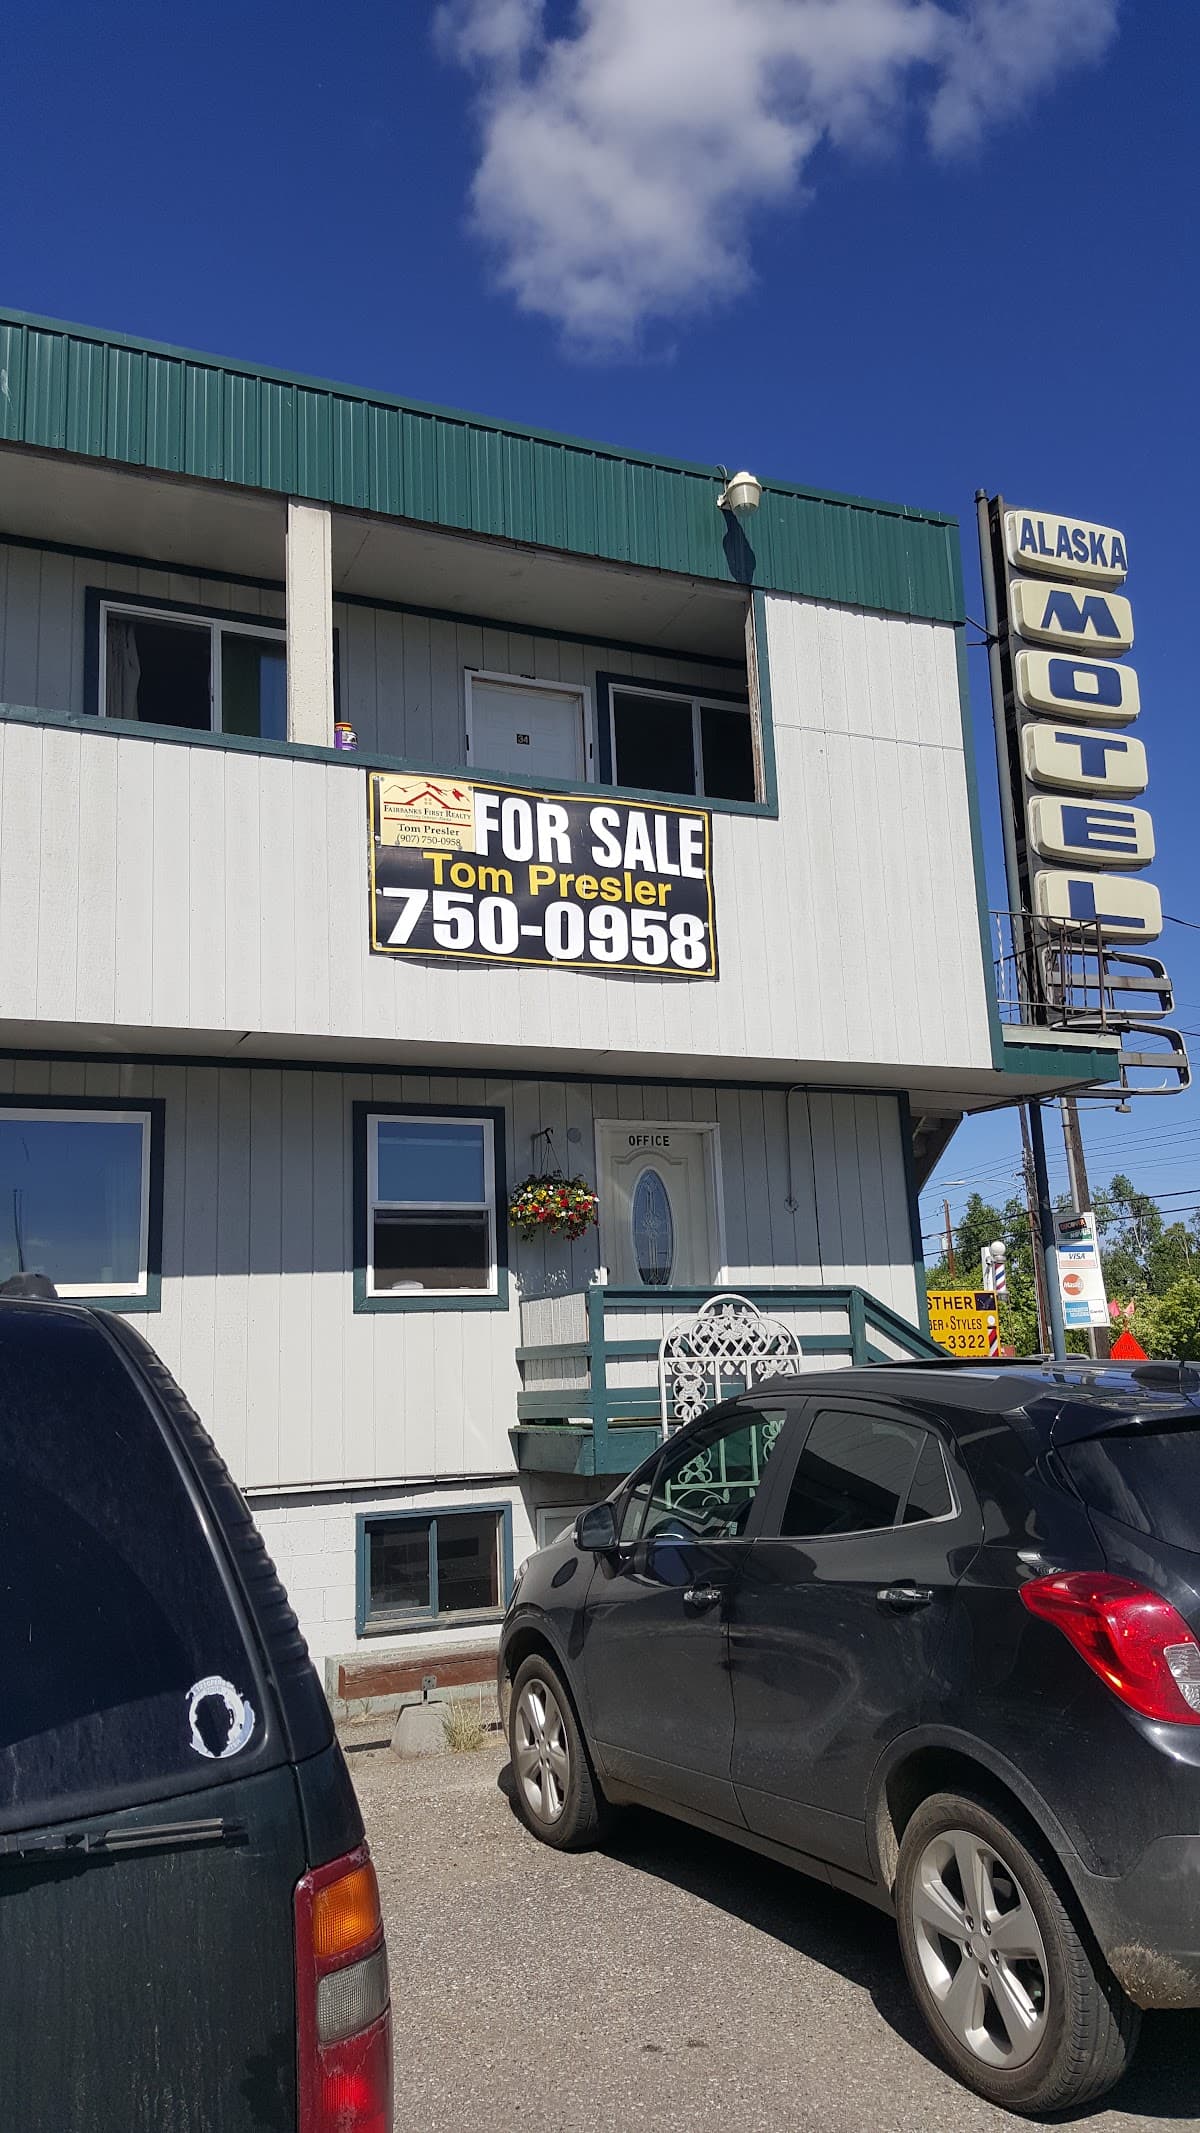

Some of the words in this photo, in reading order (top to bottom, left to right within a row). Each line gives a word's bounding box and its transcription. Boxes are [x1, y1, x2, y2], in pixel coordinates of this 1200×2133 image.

[1020, 517, 1127, 571] ALASKA
[1041, 590, 1146, 929] MOTEL
[397, 834, 419, 844] (907)
[421, 835, 461, 847] 750-0958
[398, 823, 420, 833] Tom
[424, 825, 460, 836] Presler
[474, 792, 572, 864] FOR
[589, 807, 705, 879] SALE
[423, 852, 513, 894] Tom
[528, 864, 672, 906] Presler
[382, 887, 707, 969] 750-0958
[628, 1135, 670, 1147] OFFICE
[950, 1315, 983, 1331] STYLES
[932, 1334, 986, 1349] -3322
